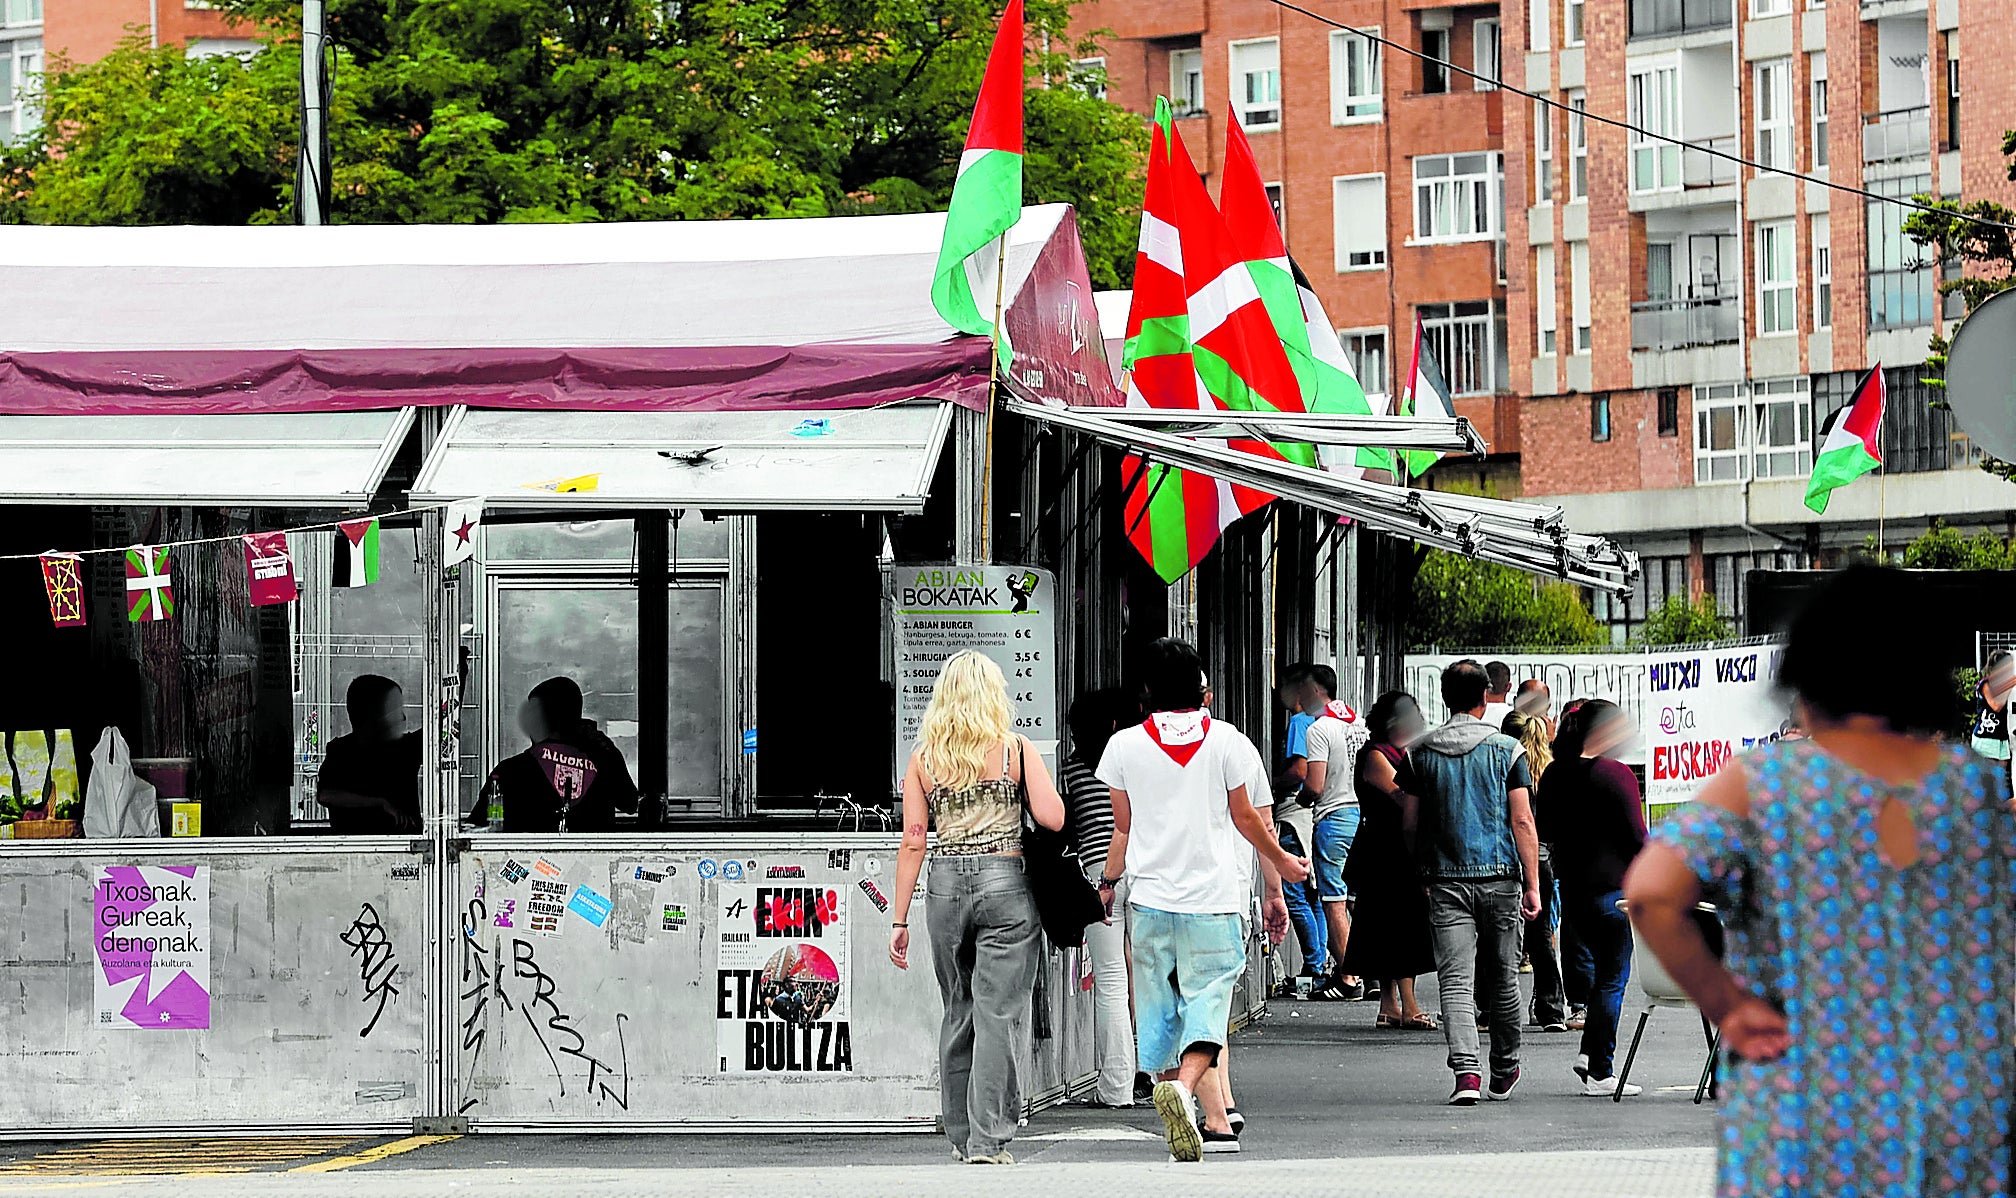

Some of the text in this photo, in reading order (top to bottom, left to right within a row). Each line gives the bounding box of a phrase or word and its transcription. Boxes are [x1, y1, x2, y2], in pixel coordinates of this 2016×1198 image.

[915, 570, 984, 587] ABIAN
[903, 587, 999, 606] BOKATAK
[913, 621, 939, 629] ABIAN
[941, 621, 973, 629] BURGER
[1015, 629, 1031, 638] 6 €
[1015, 652, 1040, 662] 3,5 €
[1015, 668, 1032, 677] 4 €
[1649, 658, 1701, 692] MUTXO
[1716, 654, 1757, 683] VASCO
[1015, 692, 1032, 701] 4 €
[1015, 717, 1042, 727] 0,5 €
[1653, 740, 1733, 781] EUSKARA
[101, 880, 197, 901] Txosnak.
[528, 902, 564, 914] FREEDOM
[101, 905, 193, 929] Gureak,
[101, 931, 203, 952] denonak.
[101, 958, 194, 967] Auzolana eta kultura.
[717, 969, 769, 1019] ETA
[745, 1021, 853, 1072] BULTZA
